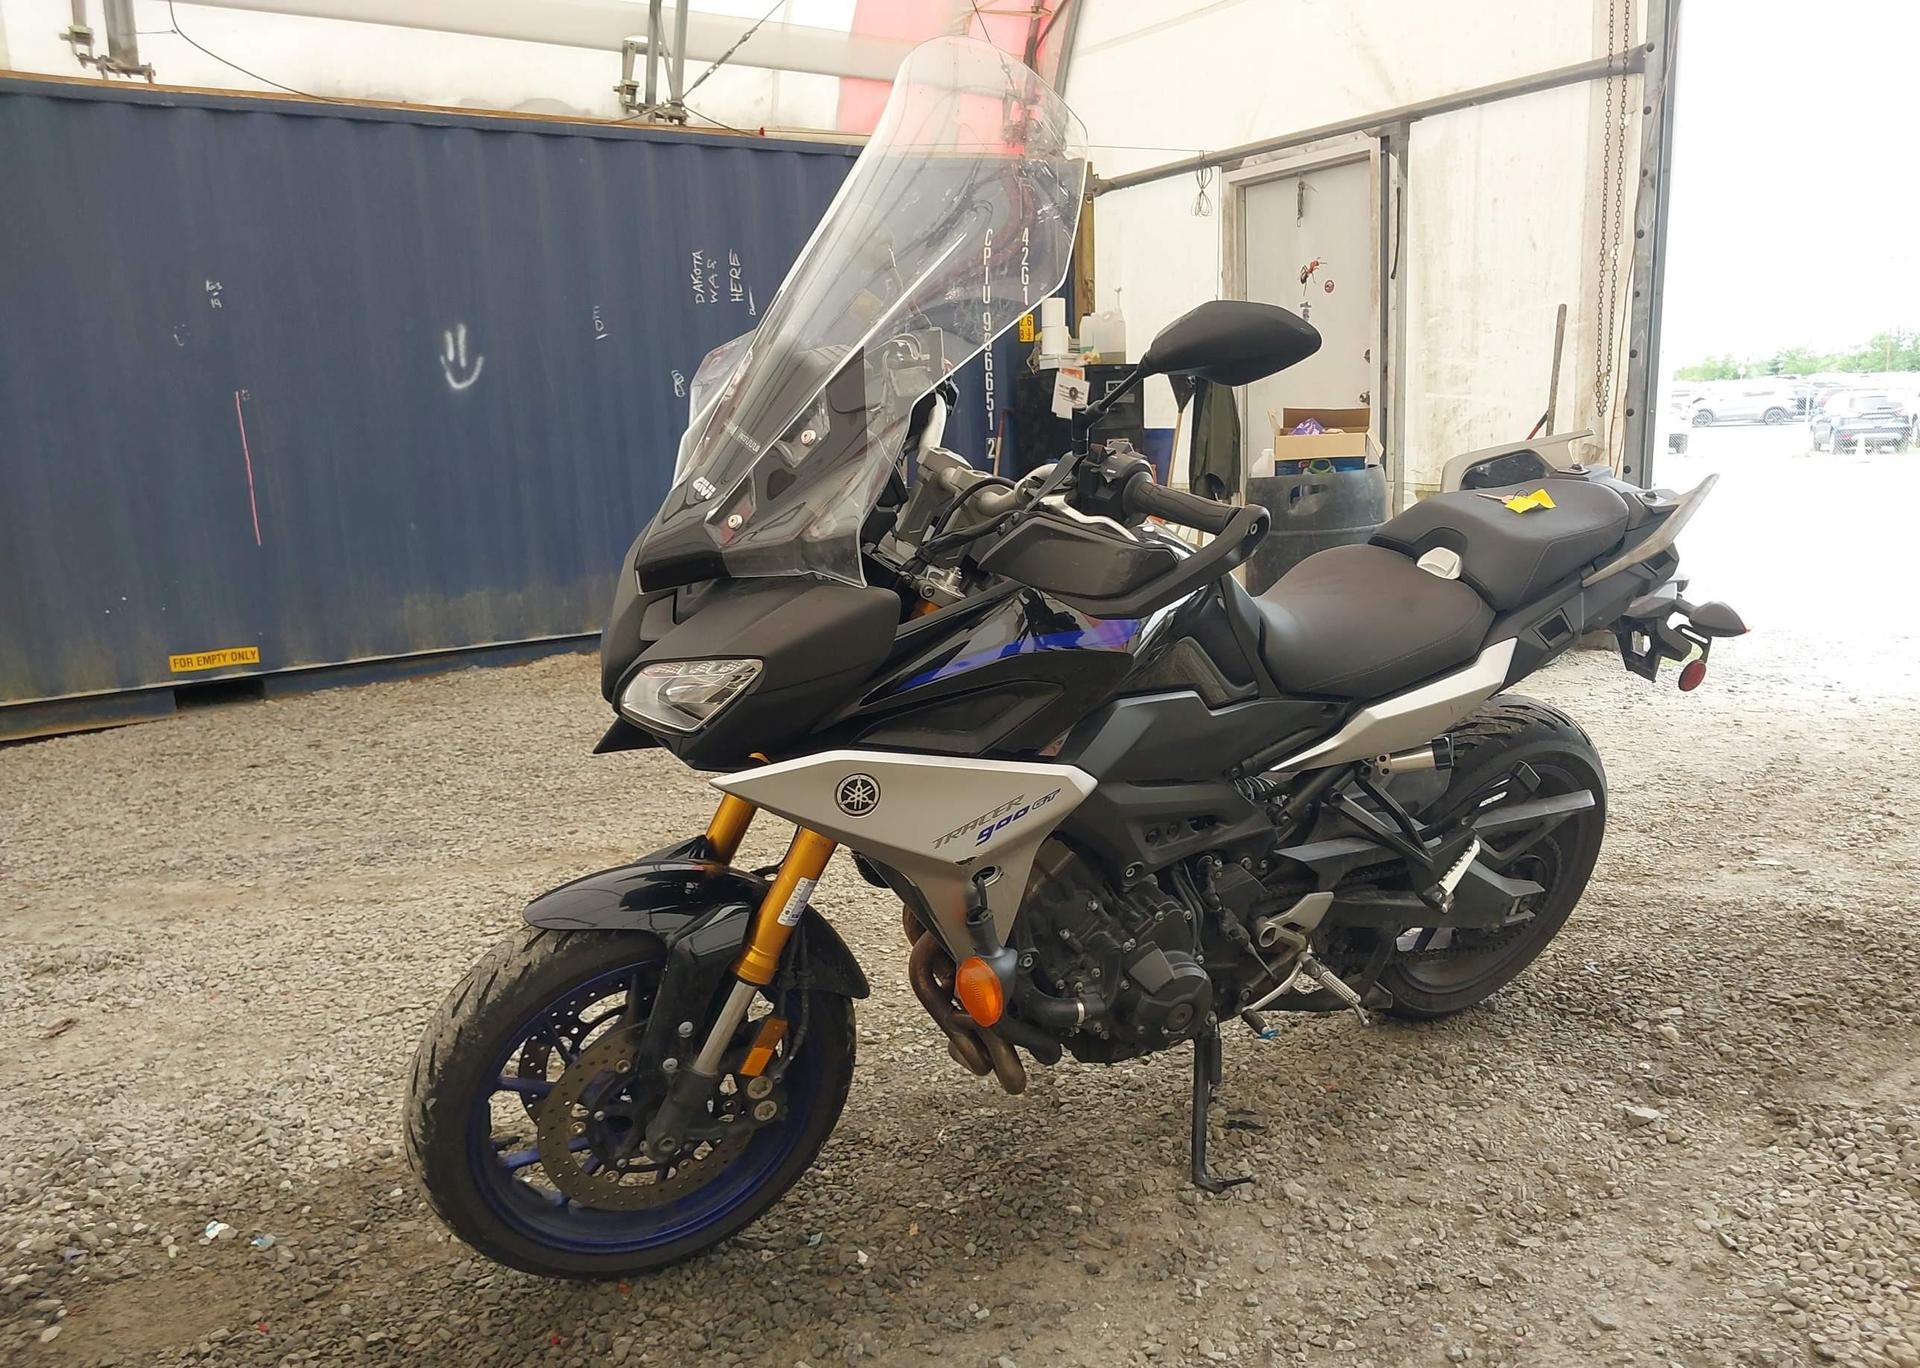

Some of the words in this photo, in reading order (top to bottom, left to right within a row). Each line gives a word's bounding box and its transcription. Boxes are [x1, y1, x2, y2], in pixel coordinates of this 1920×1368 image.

[690, 249, 705, 304] DAKOTA
[706, 258, 719, 303] WAS
[728, 248, 744, 302] HERE
[983, 228, 993, 304] CPIU
[1020, 227, 1030, 306] 42G1
[172, 657, 194, 669] FOR
[197, 653, 228, 667] EMPTY
[230, 650, 258, 662] ONLY
[931, 793, 1025, 850] TRACER
[975, 805, 1030, 847] 900
[1031, 787, 1062, 811] GT
